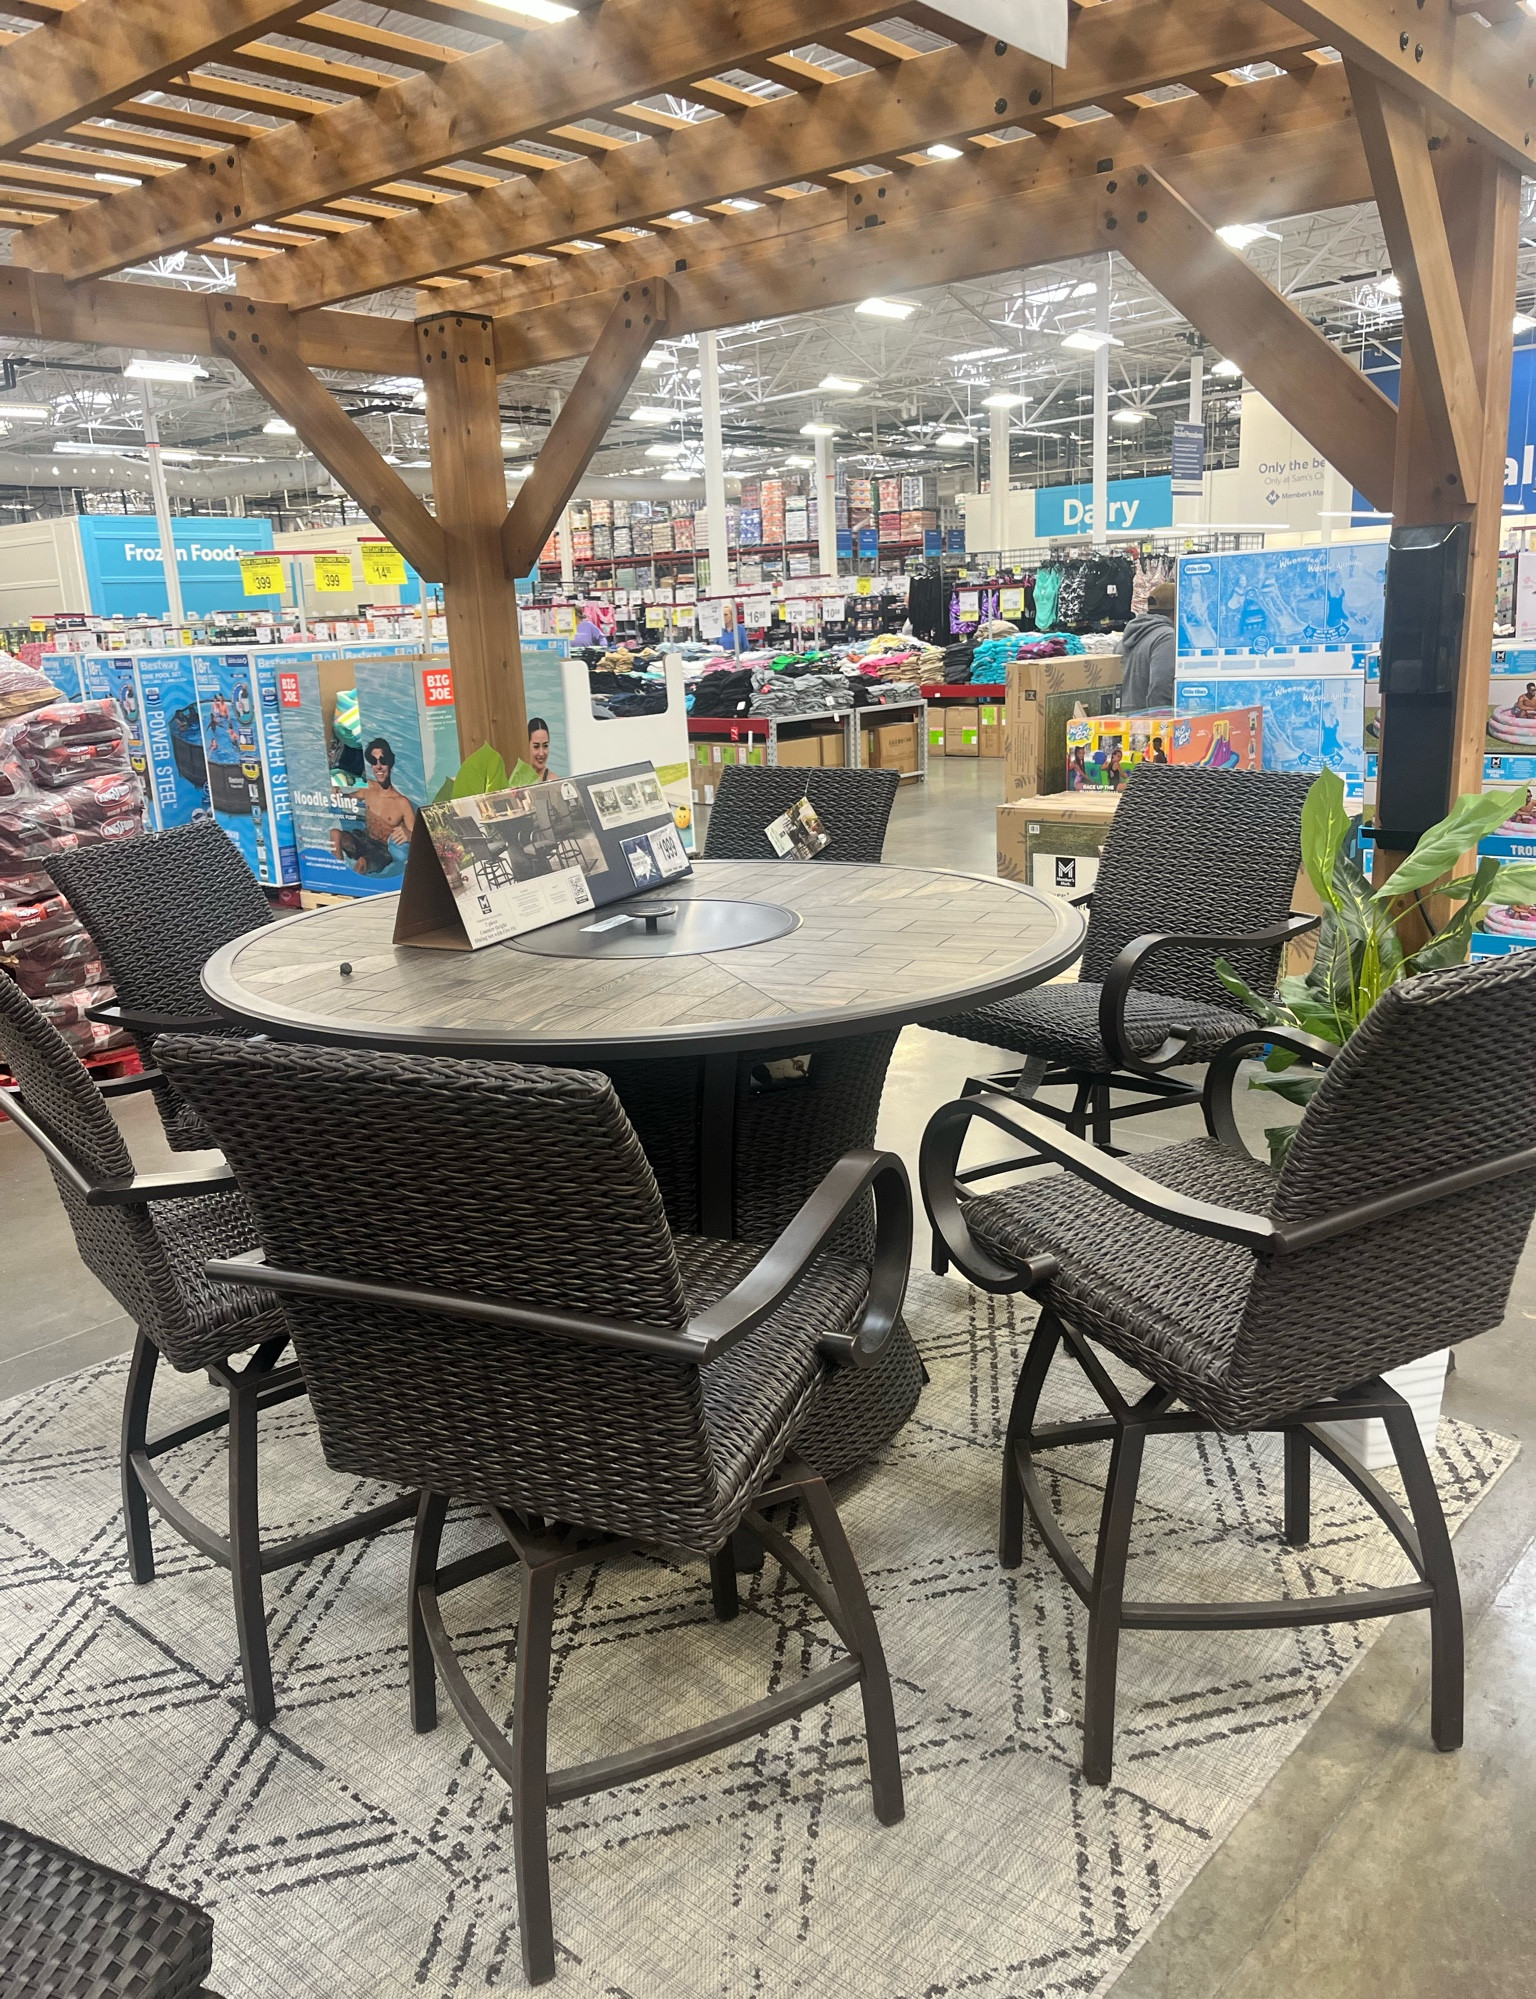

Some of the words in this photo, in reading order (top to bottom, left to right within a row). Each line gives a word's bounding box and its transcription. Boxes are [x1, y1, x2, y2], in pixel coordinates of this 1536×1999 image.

[1258, 461, 1286, 475] Only
[1289, 459, 1309, 472] the
[1312, 457, 1326, 469] be
[1503, 445, 1534, 486] al
[1264, 475, 1281, 486] Only
[1283, 474, 1291, 484] at
[1291, 472, 1313, 483] Sam's
[1281, 491, 1312, 501] Member's
[1063, 499, 1140, 528] Dary
[124, 543, 188, 562] Frozn
[139, 660, 180, 671] Bestway
[281, 678, 297, 690] BIG
[426, 674, 450, 688] BIG
[283, 690, 299, 702] JOE
[429, 687, 453, 701] JOE
[147, 710, 170, 761] POWER
[156, 766, 178, 809] STEEL
[293, 790, 329, 807] Noodle
[330, 792, 359, 813] Sling
